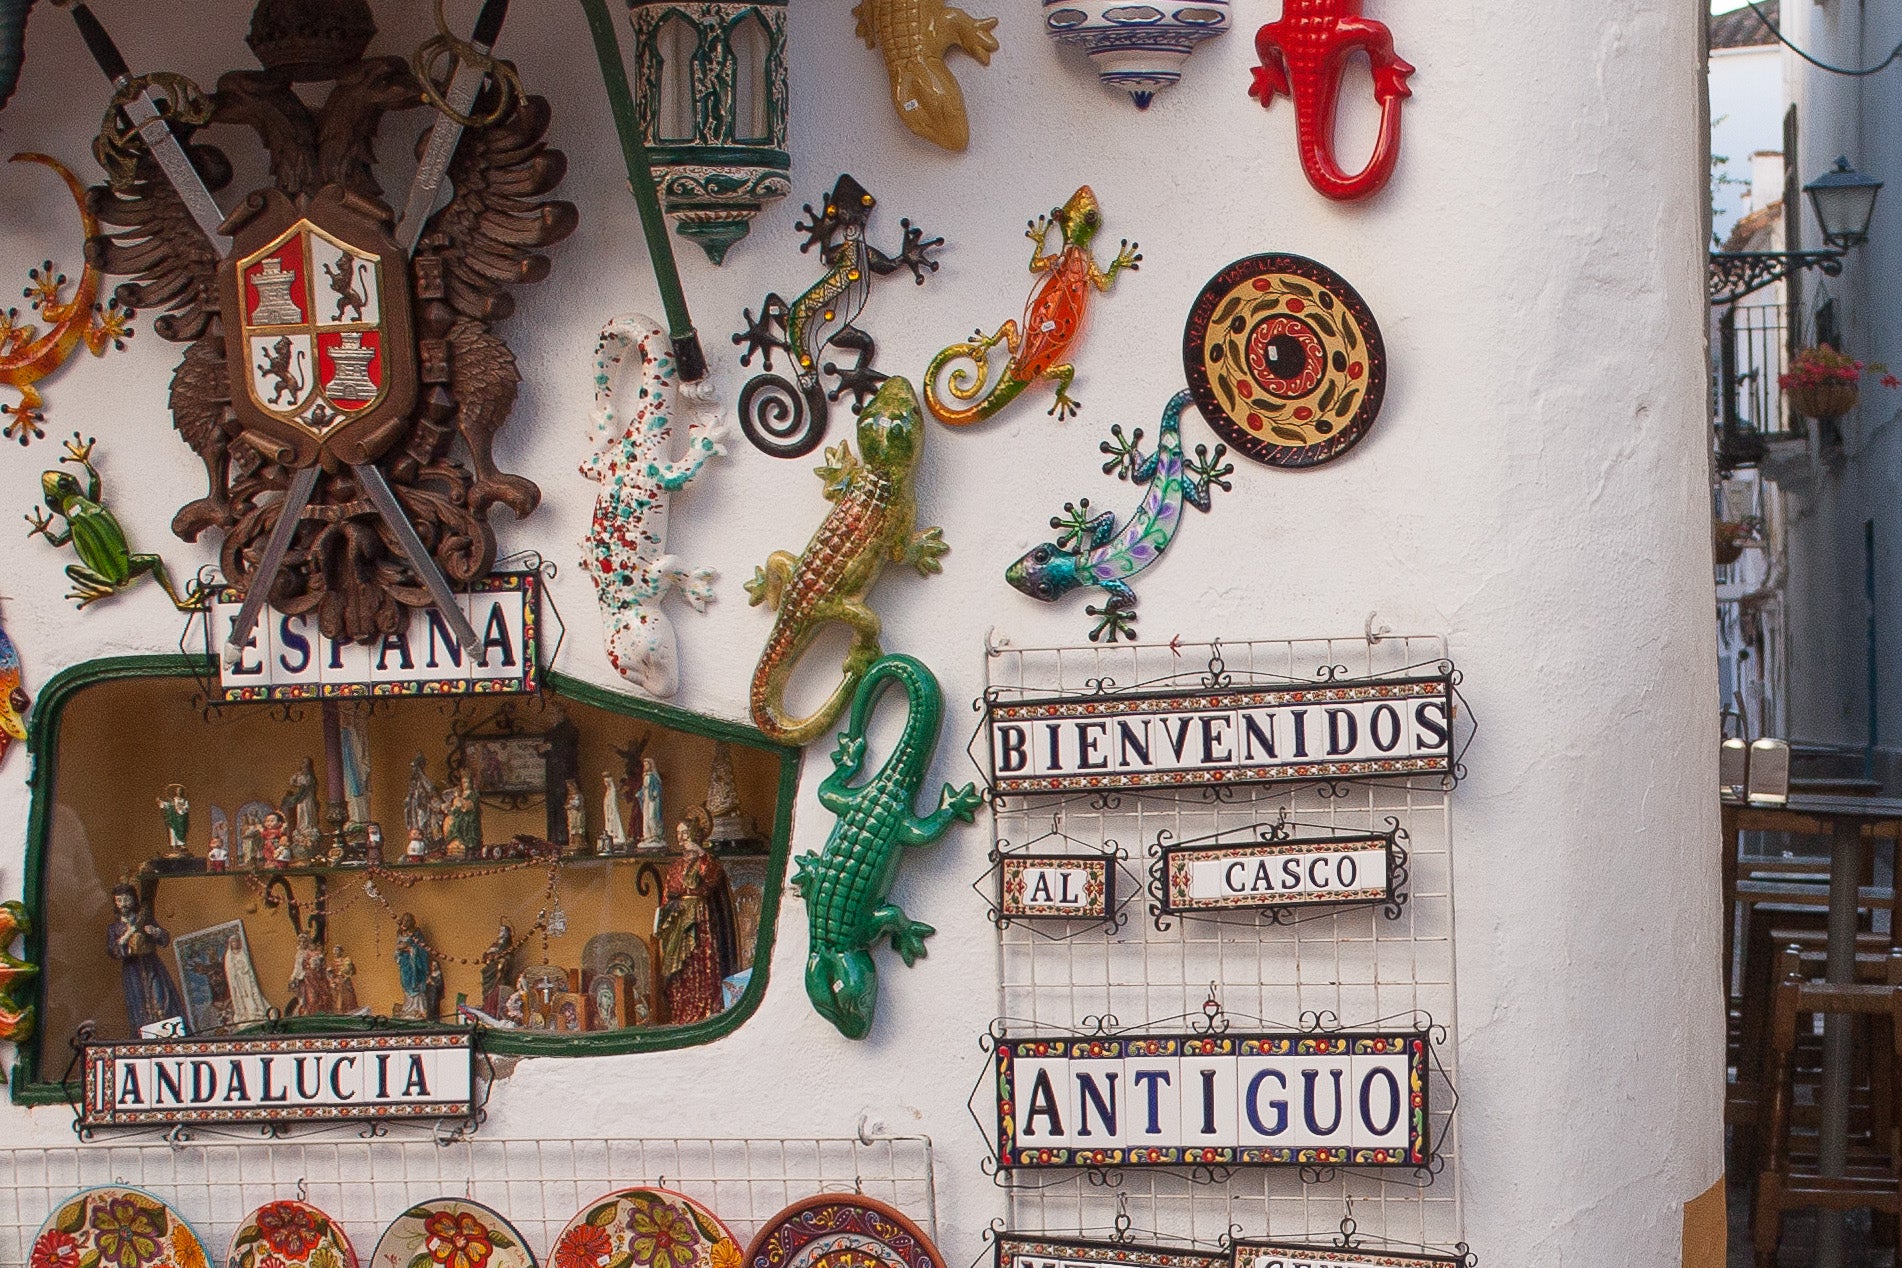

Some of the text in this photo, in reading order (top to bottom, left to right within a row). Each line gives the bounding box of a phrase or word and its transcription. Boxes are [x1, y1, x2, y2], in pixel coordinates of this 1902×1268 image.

[998, 701, 1449, 773] BIENVENIDOS
[1030, 869, 1080, 904] AL
[1224, 854, 1358, 893] CASCO
[117, 1053, 431, 1106] ANDALUCIA
[1022, 1066, 1402, 1138] ANTIGUO
